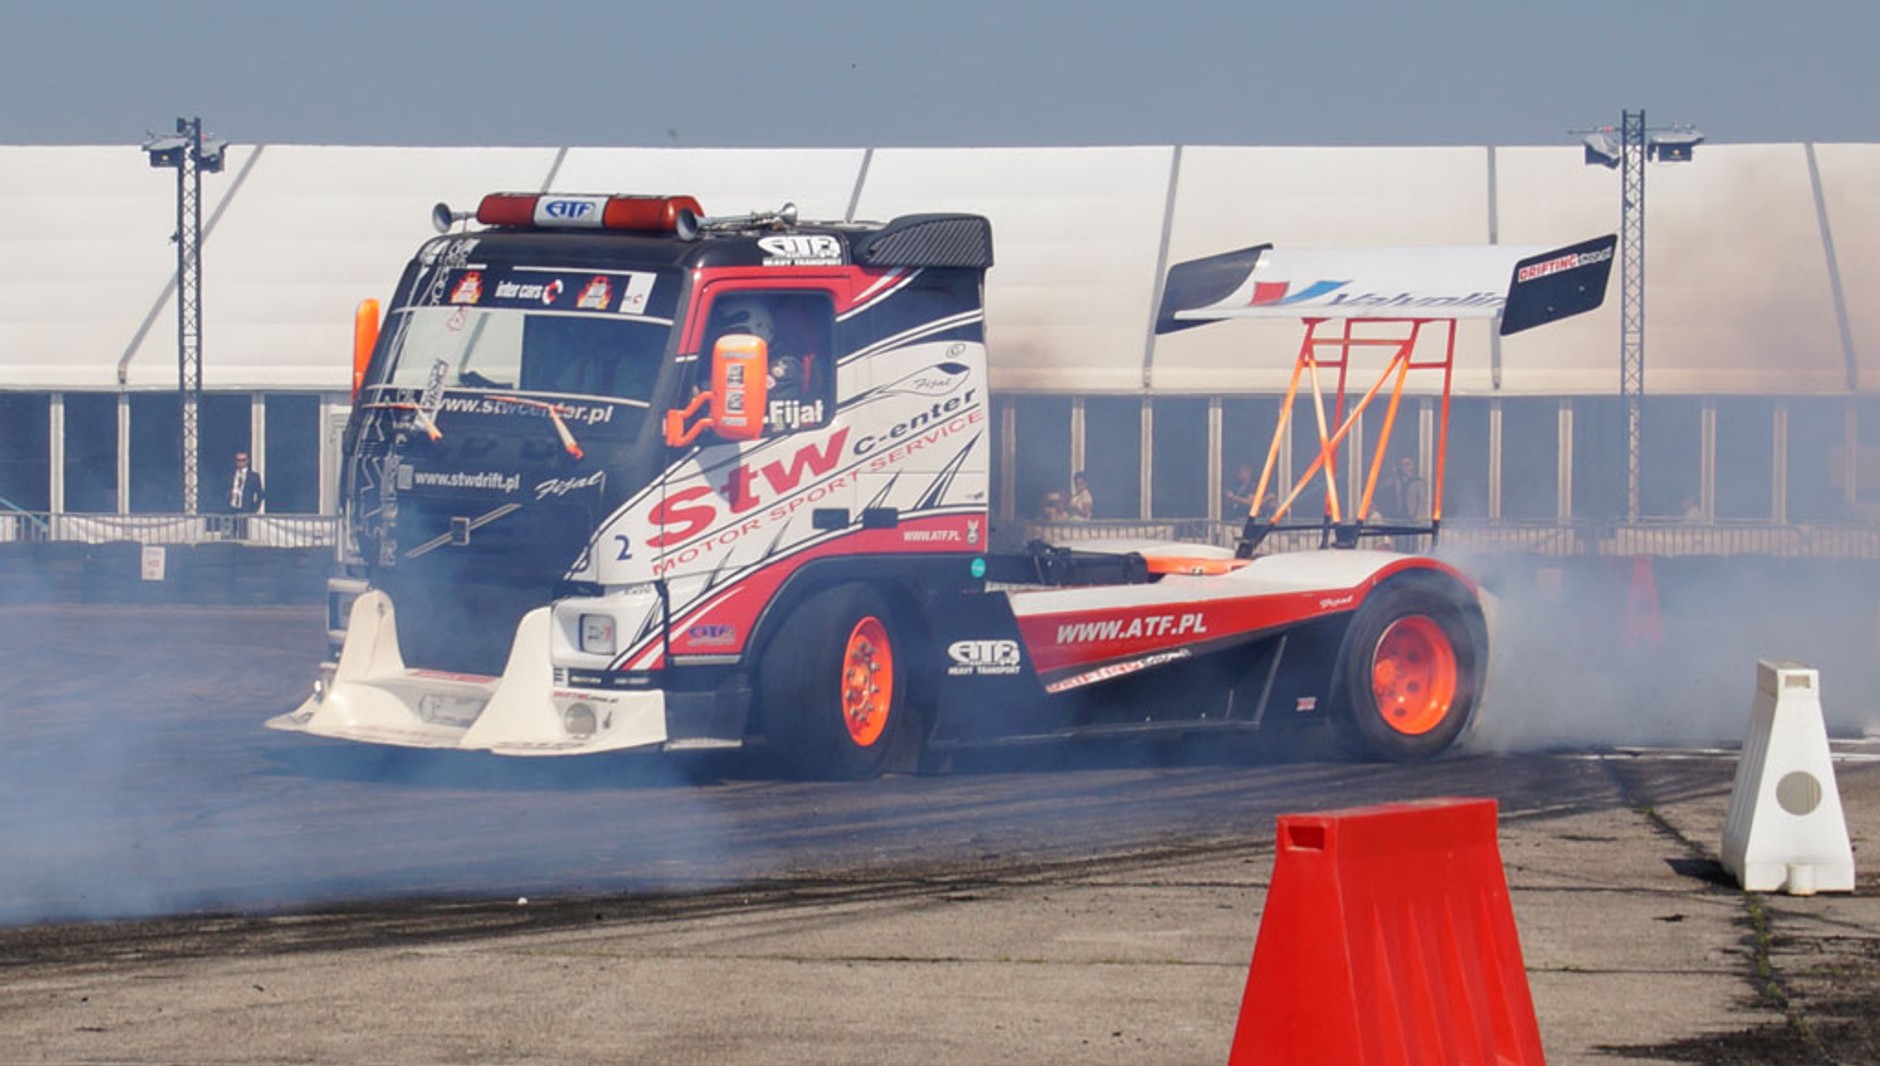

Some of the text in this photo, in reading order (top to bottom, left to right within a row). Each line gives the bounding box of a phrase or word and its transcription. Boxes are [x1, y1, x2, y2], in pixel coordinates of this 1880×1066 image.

[495, 280, 544, 299] inter cars
[415, 471, 520, 493] www.stwdrift.pl
[646, 388, 976, 548] Stw C-enter
[653, 408, 984, 576] MOTOR SPORT SERVICE
[614, 534, 633, 561] 2
[1056, 613, 1208, 644] WWW.ATF.PL
